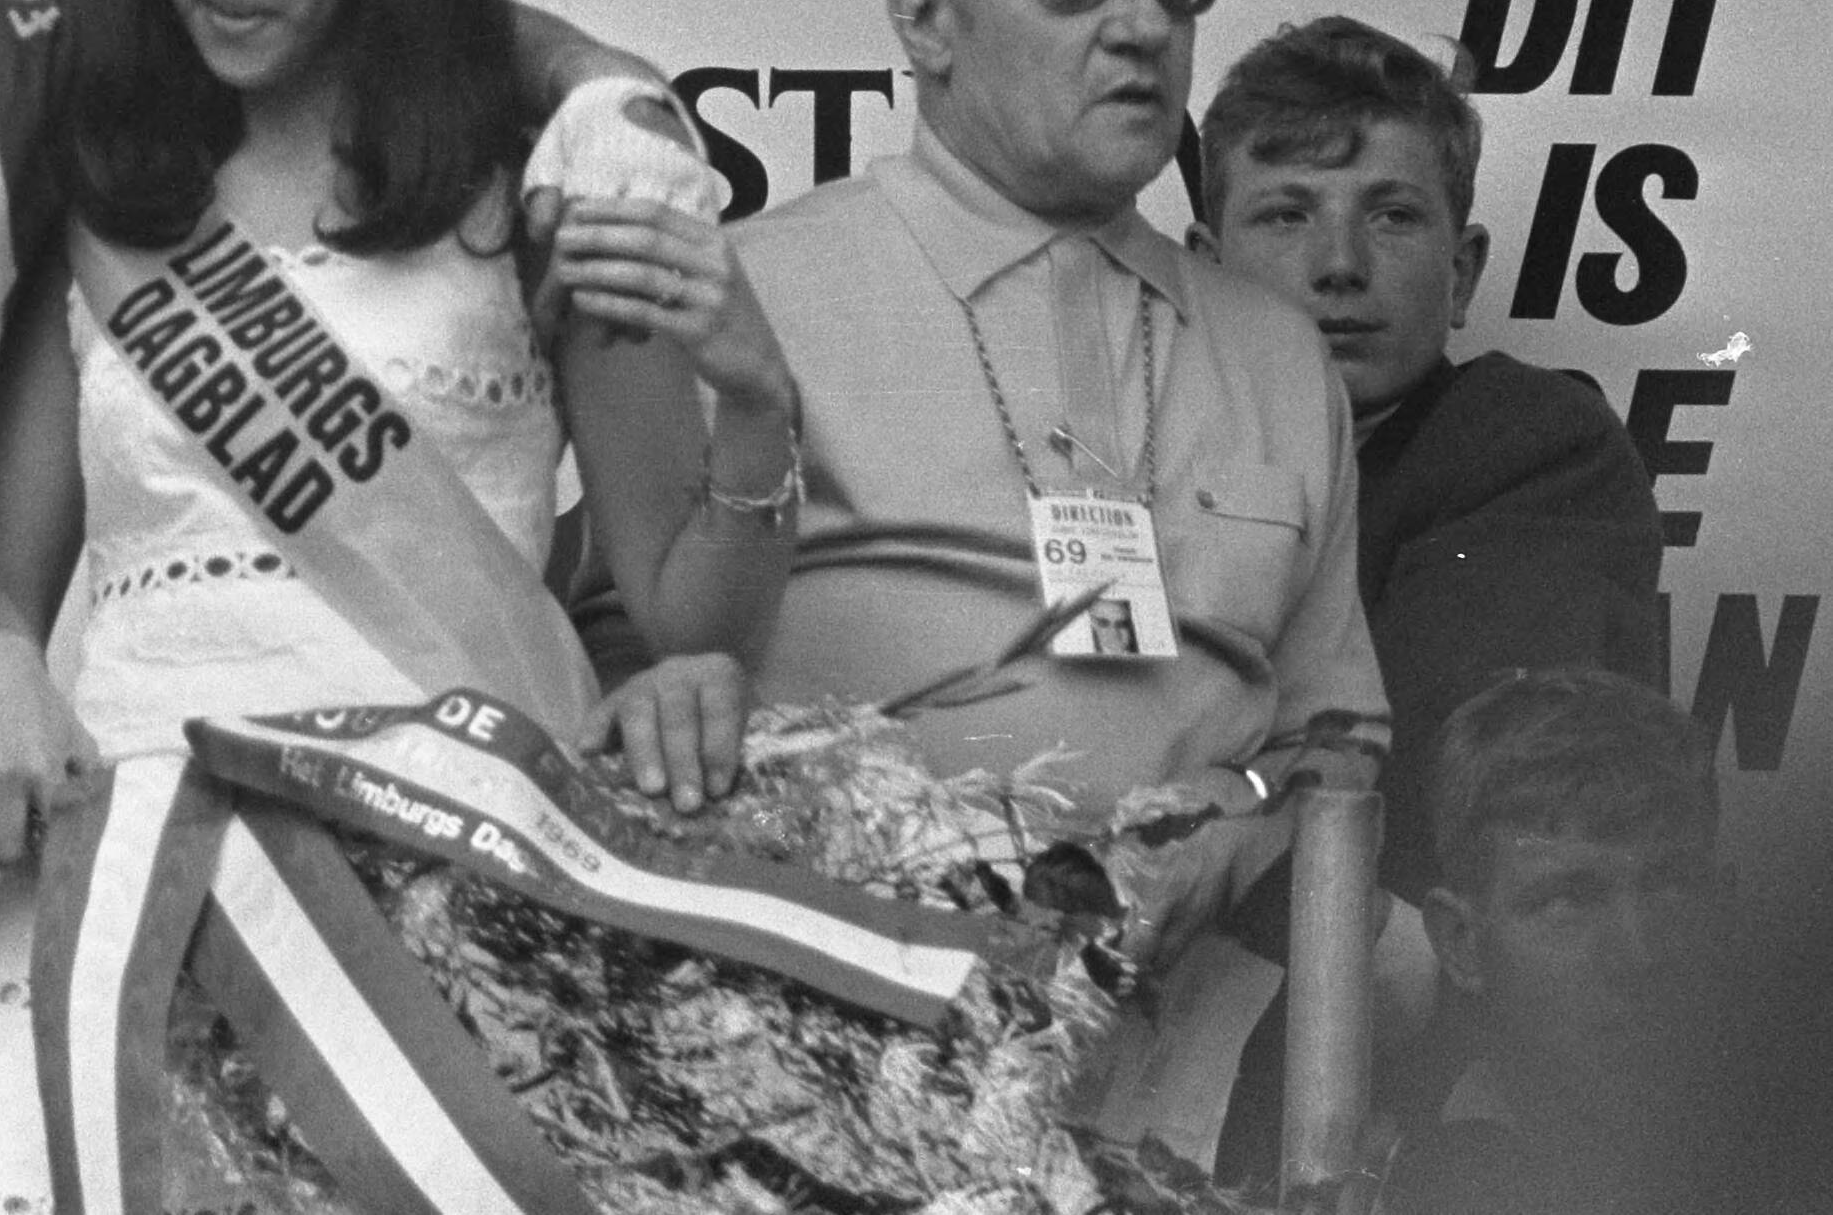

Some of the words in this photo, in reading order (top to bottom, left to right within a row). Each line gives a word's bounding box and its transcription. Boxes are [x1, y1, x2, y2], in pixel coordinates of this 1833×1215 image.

[1508, 143, 1700, 327] IS
[106, 277, 336, 535] DAGBLAD
[167, 222, 412, 484] LIMBURGS
[1577, 369, 1737, 548] E
[1043, 537, 1088, 565] 69
[333, 764, 465, 840] Limburgs
[434, 694, 507, 742] DE
